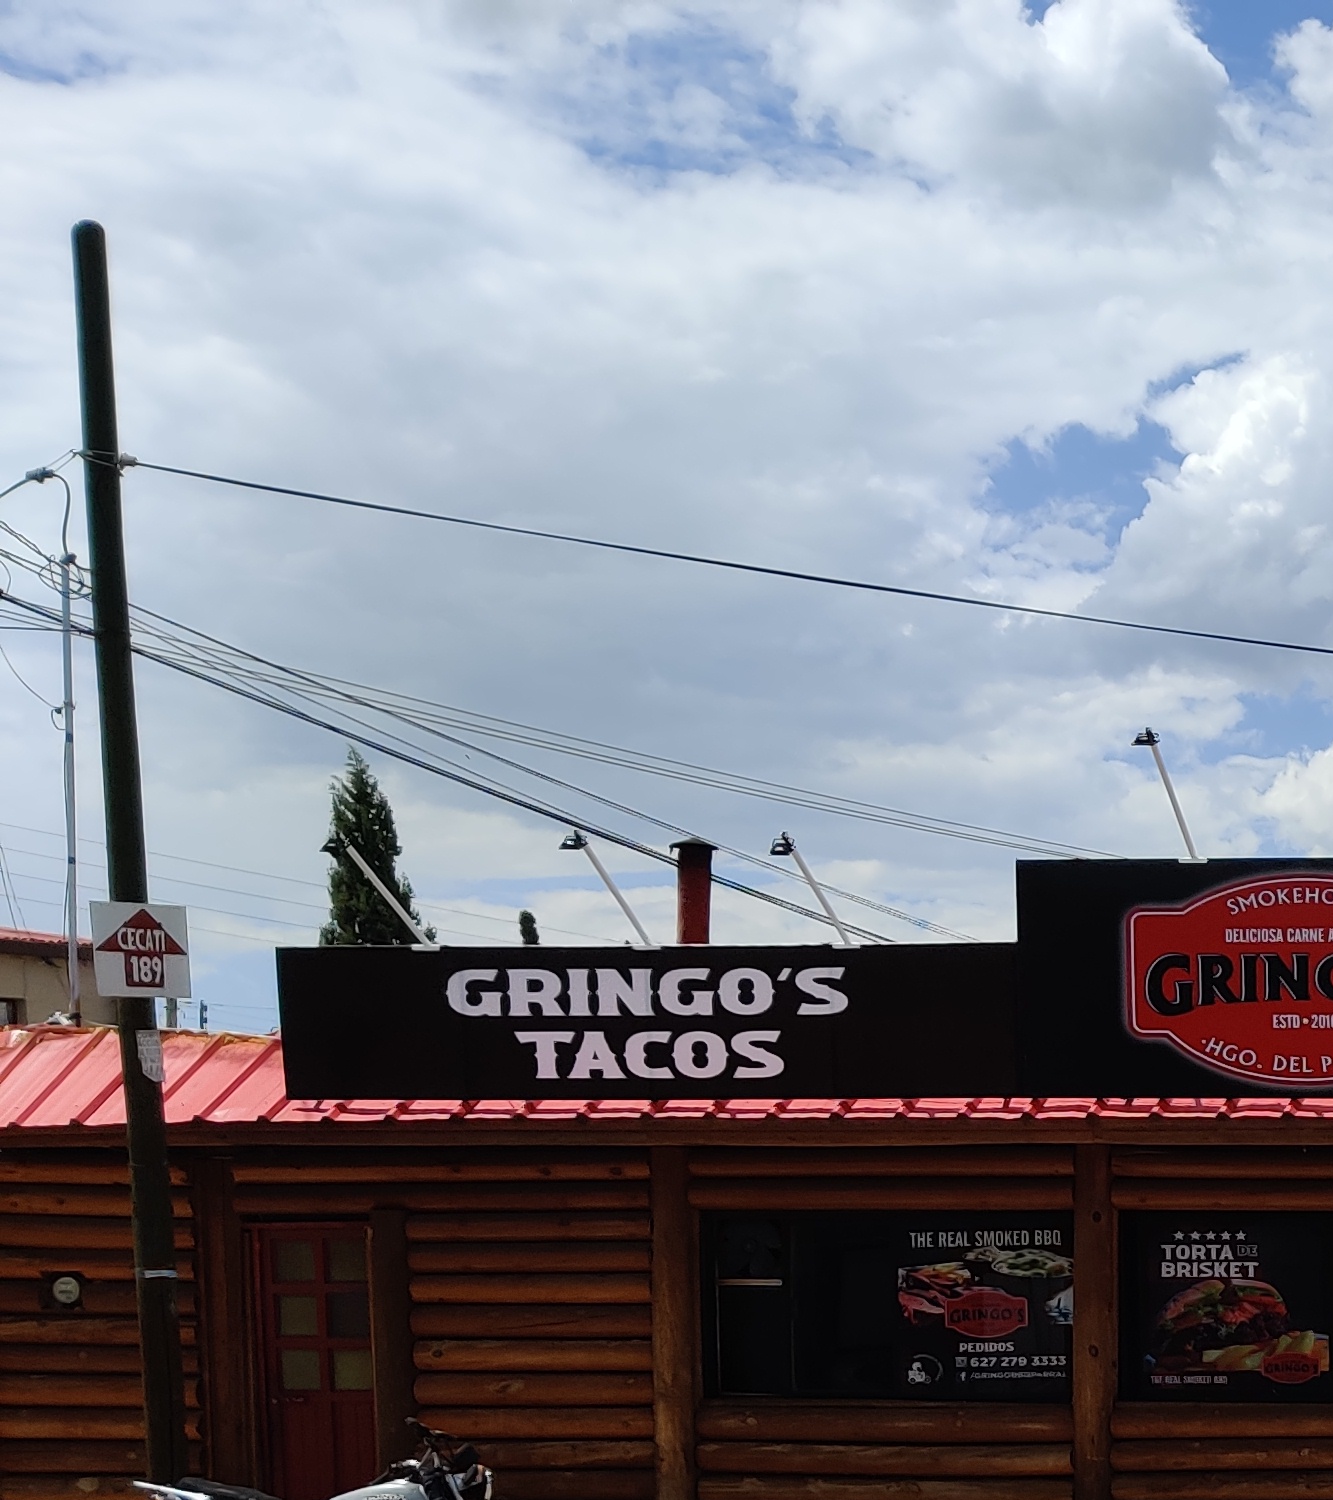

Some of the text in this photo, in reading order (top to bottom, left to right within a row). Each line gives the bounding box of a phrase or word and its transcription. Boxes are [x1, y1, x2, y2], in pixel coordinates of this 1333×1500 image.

[117, 927, 165, 952] CECATI
[1225, 927, 1284, 944] DELICIOSA
[1287, 927, 1325, 944] CARNE
[130, 956, 162, 984] 189
[446, 966, 849, 1016] GRINGO'S
[514, 1030, 785, 1079] TACOS
[1273, 1055, 1314, 1072] DEL
[909, 1230, 1062, 1249] THE REAL SMOKED BBQ
[1160, 1244, 1258, 1260] TORTA DE
[1160, 1261, 1260, 1278] BRISKET
[950, 1308, 1024, 1324] GRINGO'S
[959, 1342, 1015, 1353] PEDIDOS
[970, 1357, 998, 1368] 627
[1264, 1362, 1319, 1374] GRINGOS
